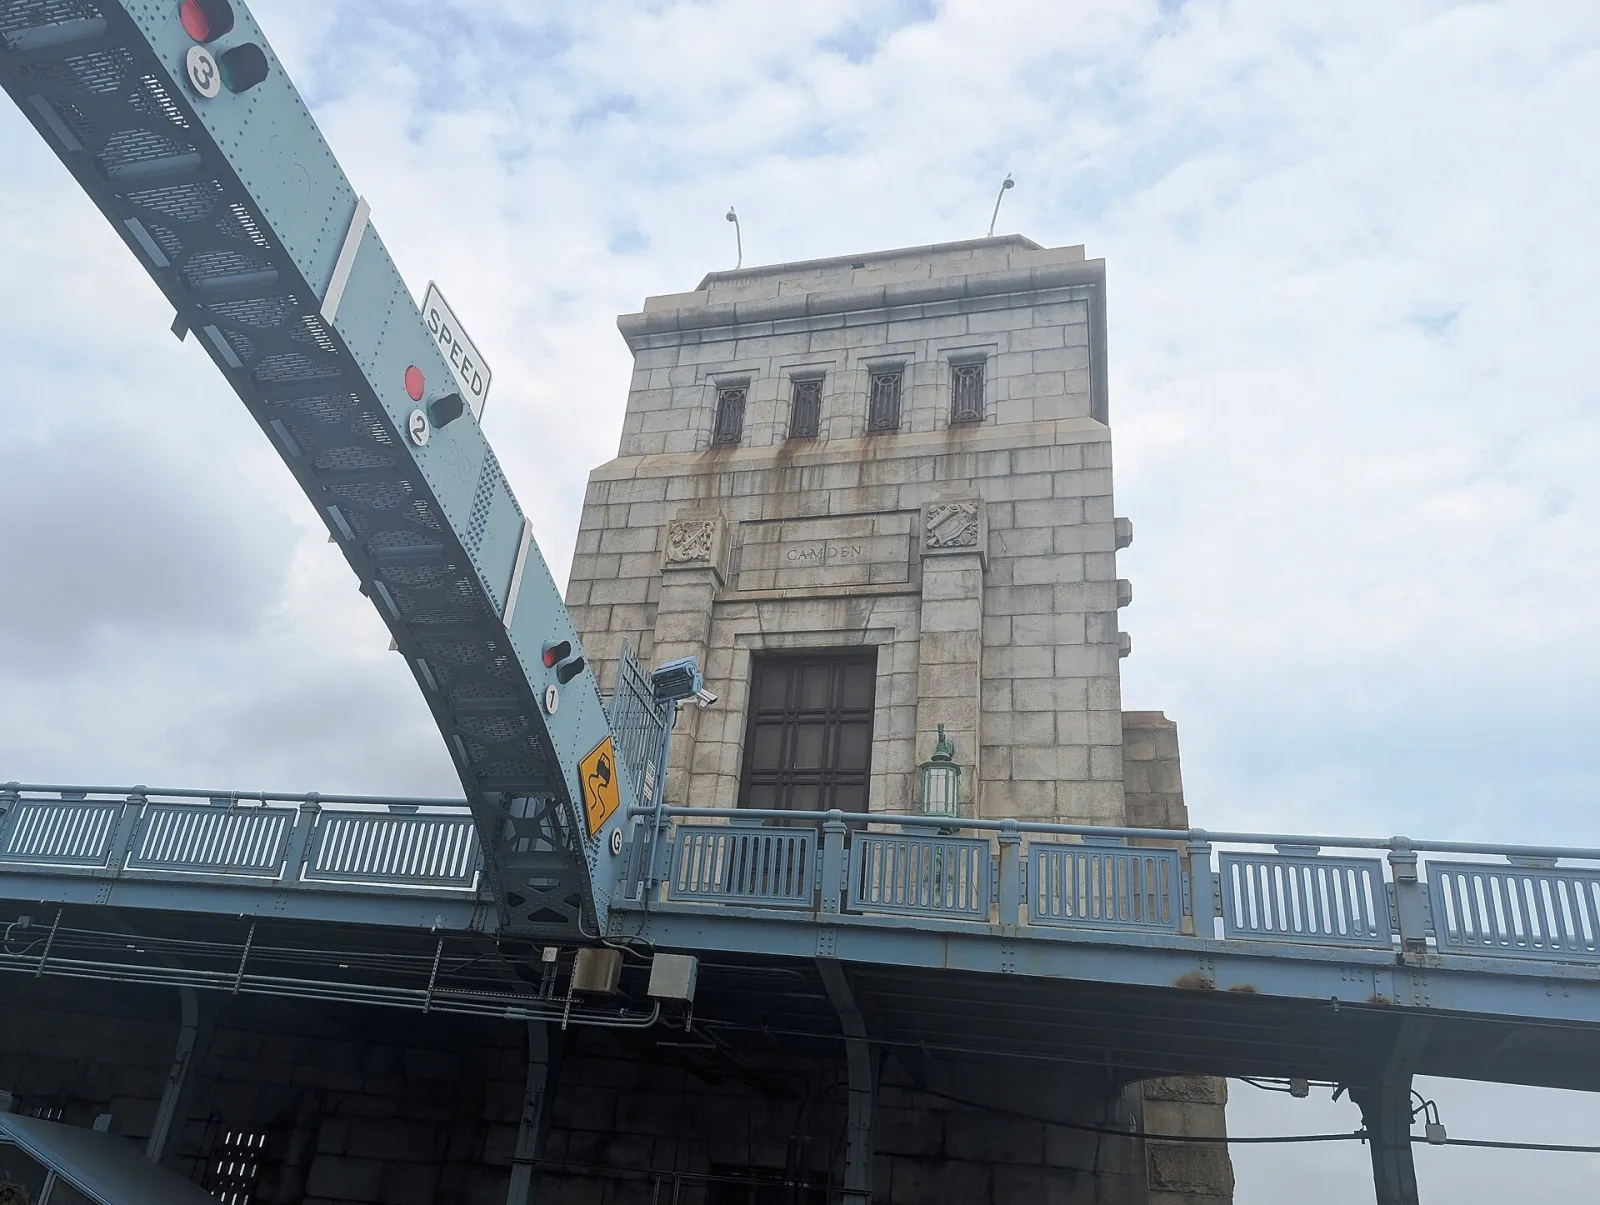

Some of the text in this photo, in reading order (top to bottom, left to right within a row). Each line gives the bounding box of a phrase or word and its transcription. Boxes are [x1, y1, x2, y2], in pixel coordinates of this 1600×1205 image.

[193, 56, 213, 90] 3
[427, 308, 482, 396] SPEED
[412, 415, 426, 442] 2
[787, 546, 862, 561] CAMDEN
[613, 831, 621, 851] G
